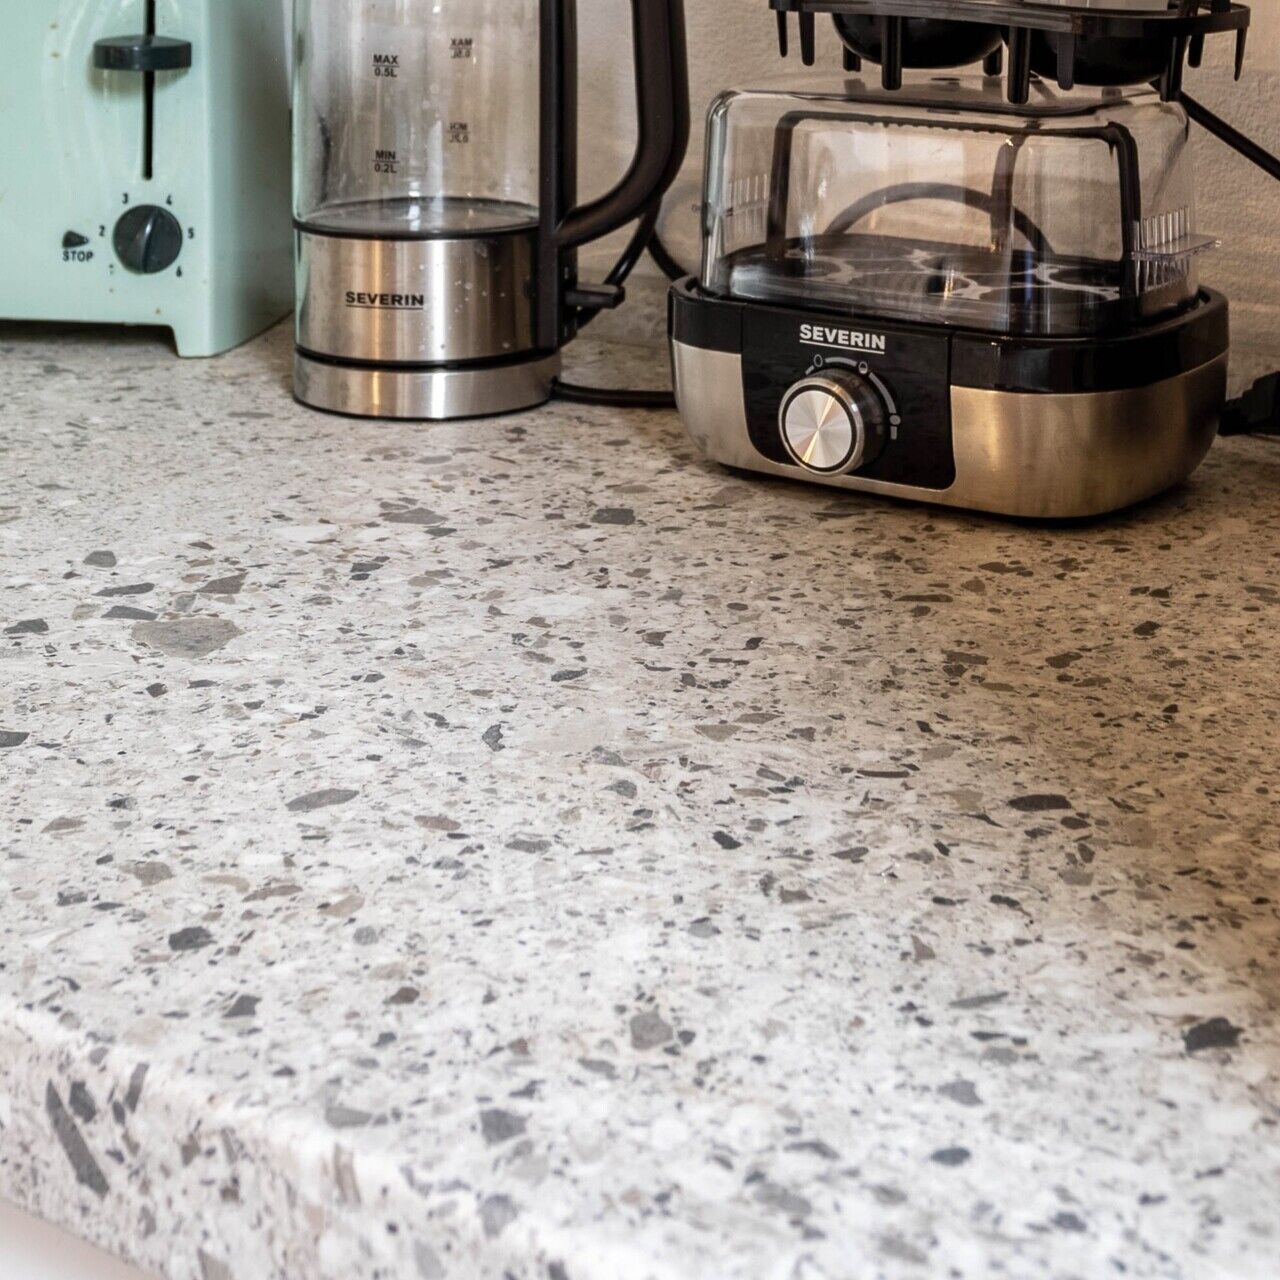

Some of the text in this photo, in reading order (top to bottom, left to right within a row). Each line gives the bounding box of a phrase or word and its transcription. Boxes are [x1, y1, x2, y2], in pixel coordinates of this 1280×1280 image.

[373, 54, 398, 64] MAX
[374, 67, 397, 77] 0.5L
[375, 150, 396, 160] MIN
[374, 163, 397, 174] 0.2L
[122, 193, 129, 204] 3
[99, 225, 105, 237] 2
[188, 227, 194, 239] 5
[62, 250, 94, 262] STOP
[345, 291, 424, 306] SEVERIN
[800, 324, 885, 350] SEVERIN
